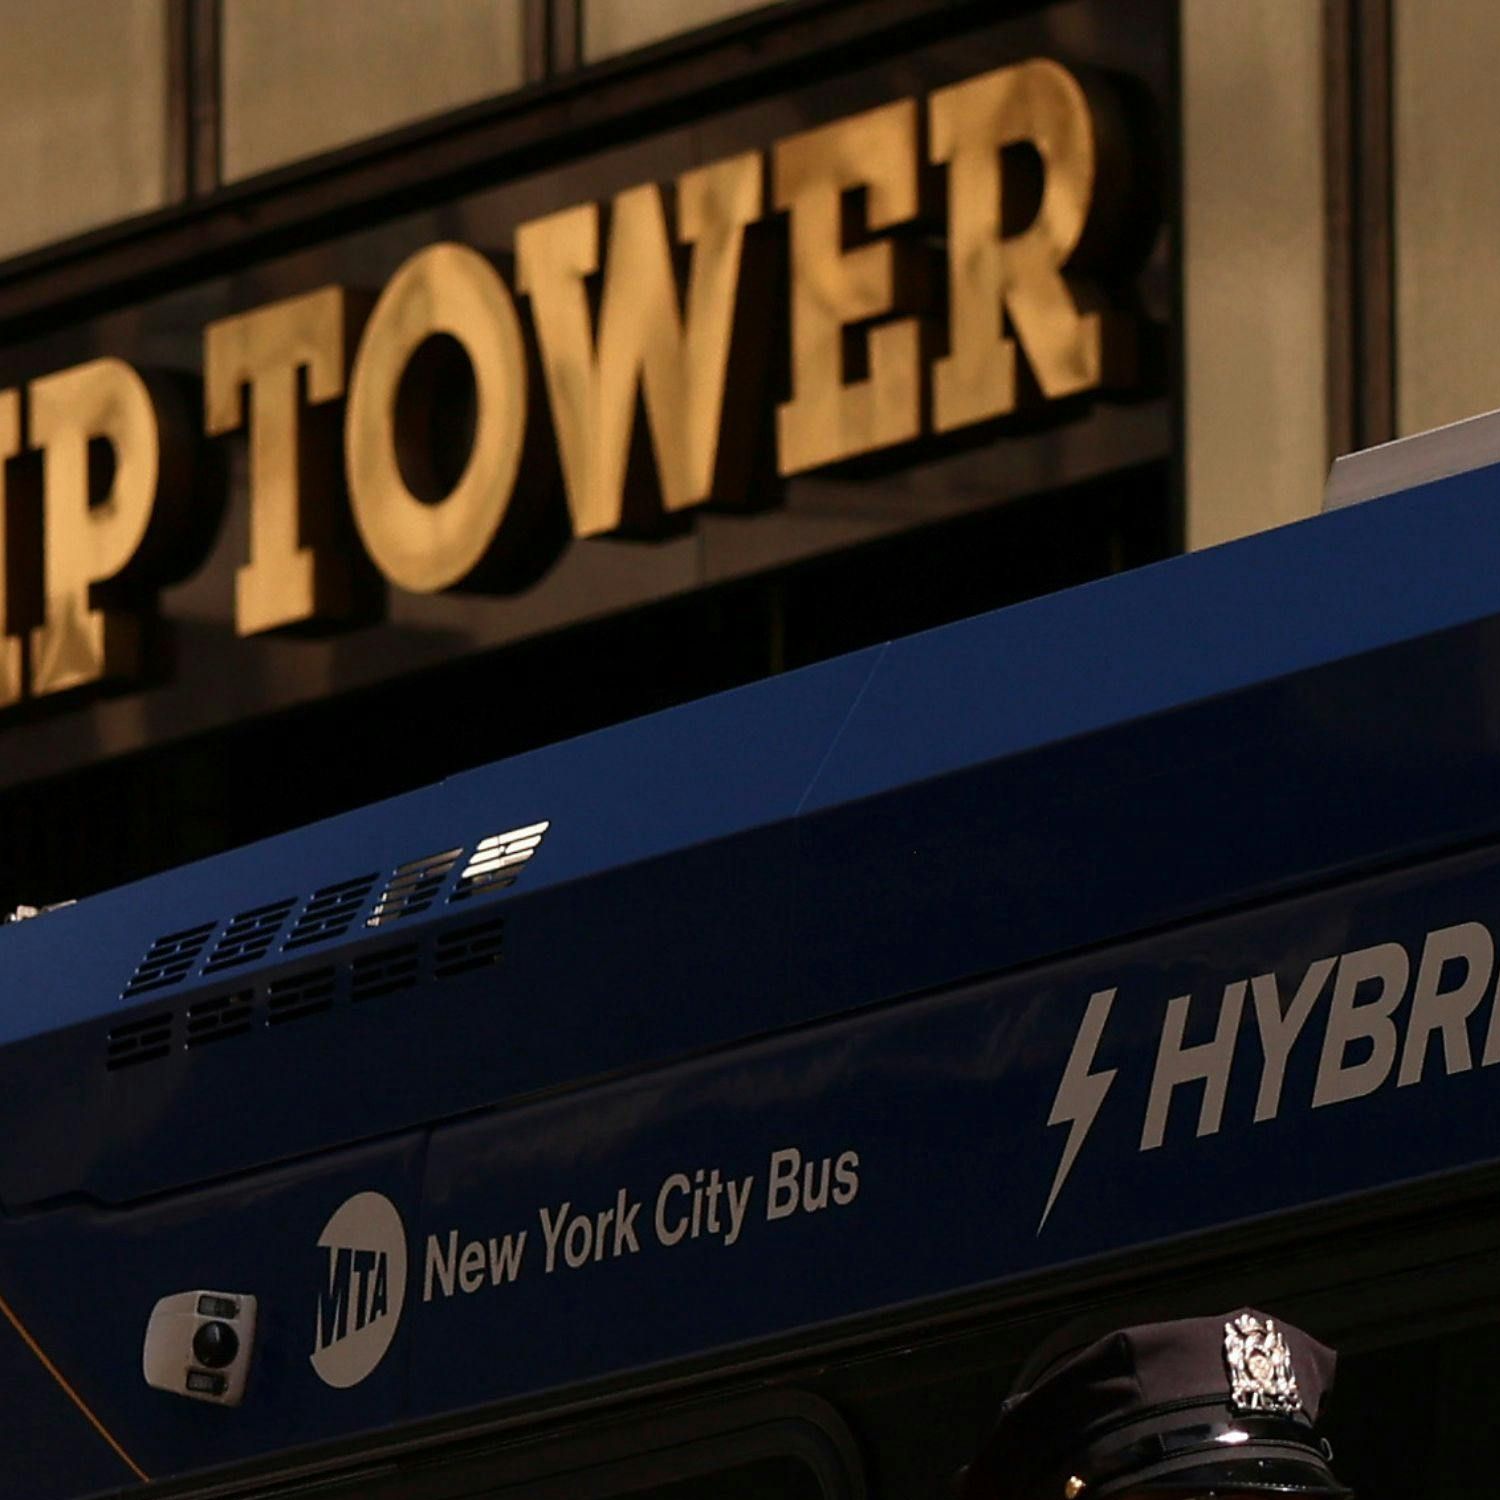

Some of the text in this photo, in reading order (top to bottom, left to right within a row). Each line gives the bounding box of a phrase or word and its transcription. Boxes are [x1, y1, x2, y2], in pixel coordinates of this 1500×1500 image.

[0, 57, 1100, 707] P TOWER
[422, 1146, 860, 1302] New York City Bus
